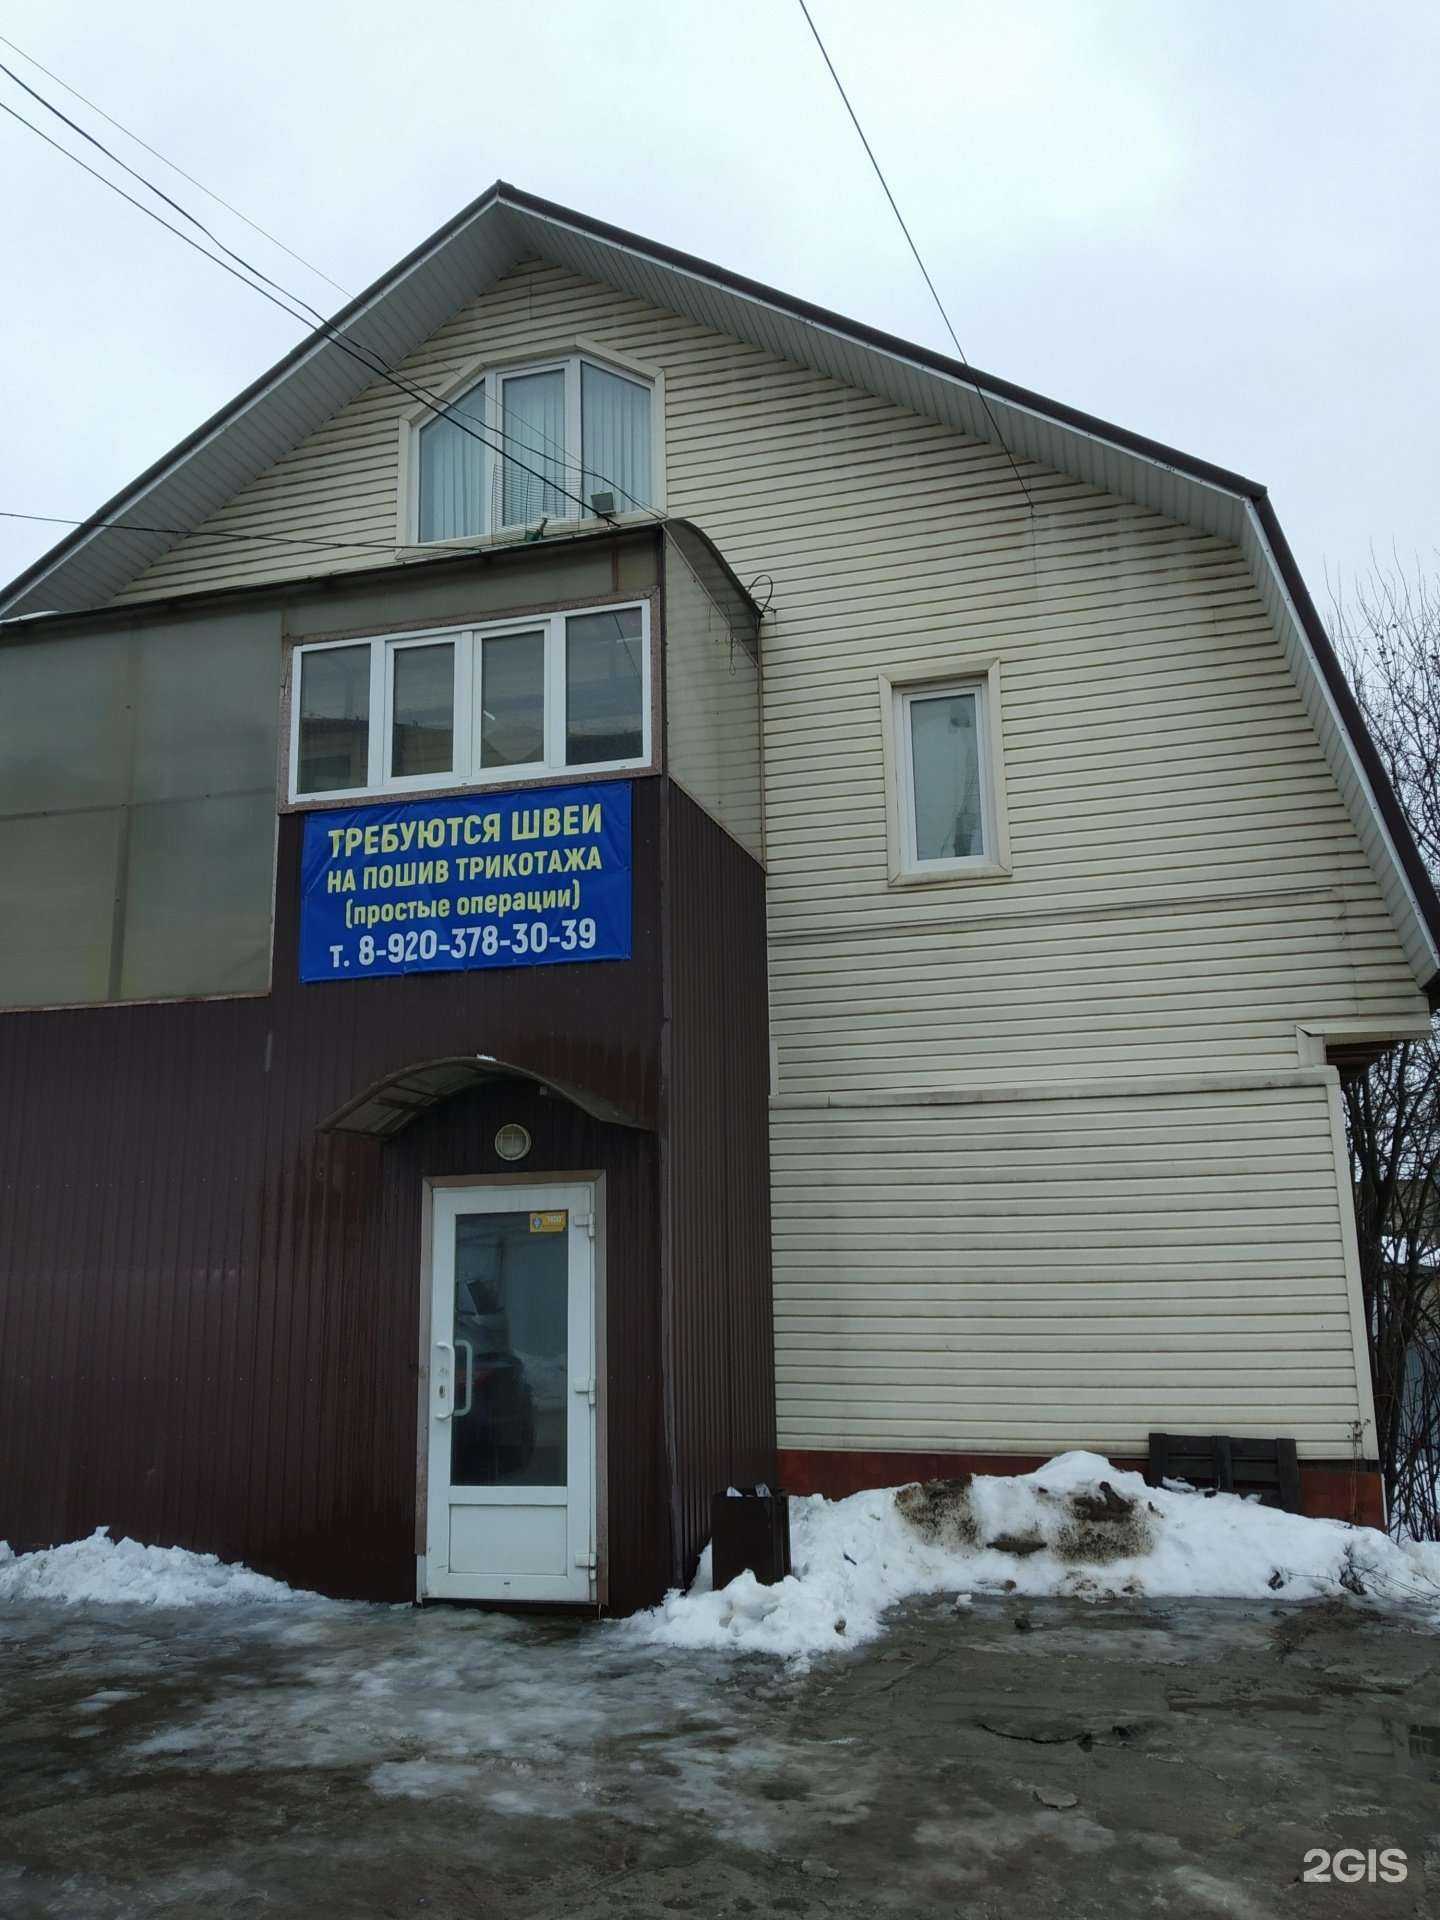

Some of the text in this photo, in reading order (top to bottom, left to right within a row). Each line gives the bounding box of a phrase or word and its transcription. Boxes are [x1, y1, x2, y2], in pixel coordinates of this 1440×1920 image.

[328, 803, 602, 858] ТРЕБУЮТСЯ ШВЕИ
[327, 845, 602, 894] НА ПОШИВ ТРИКОТАЖА
[345, 879, 580, 929] (простые операции)
[358, 917, 597, 966] 8-920-378-30-39
